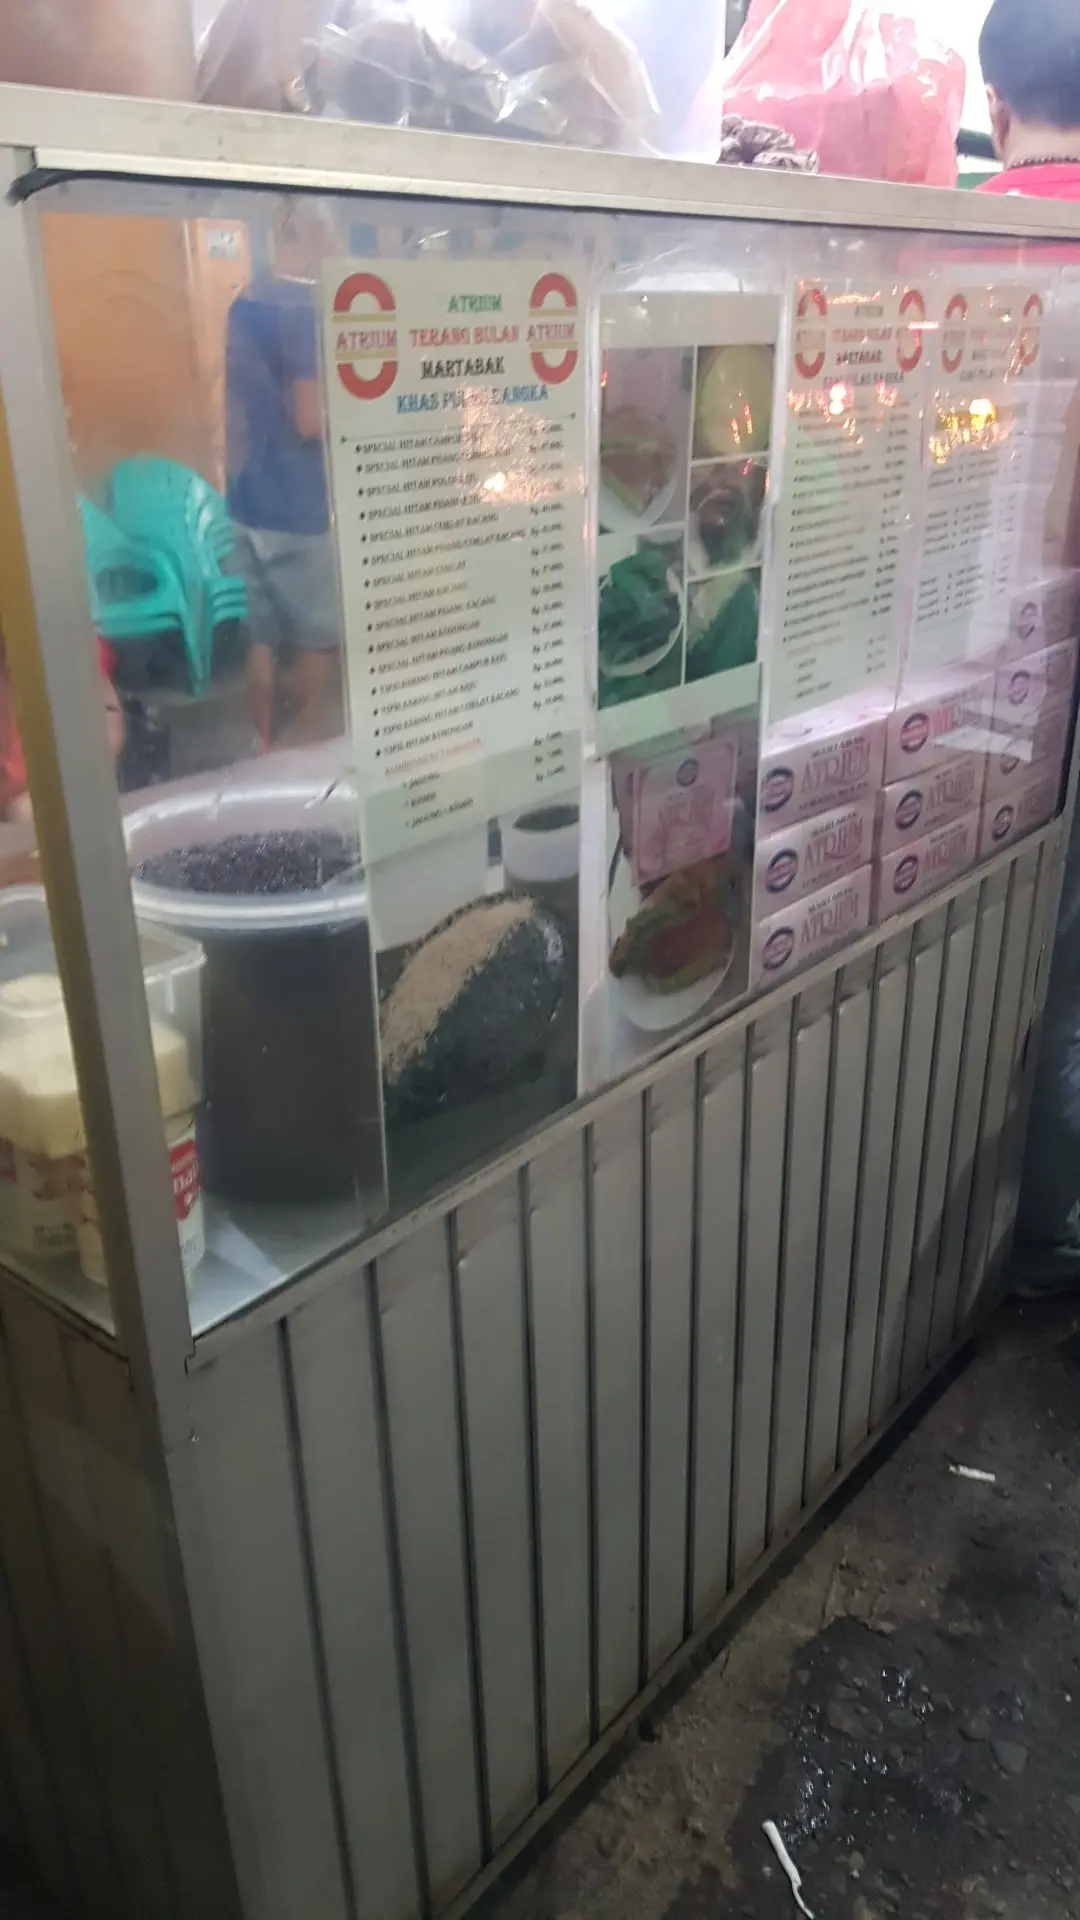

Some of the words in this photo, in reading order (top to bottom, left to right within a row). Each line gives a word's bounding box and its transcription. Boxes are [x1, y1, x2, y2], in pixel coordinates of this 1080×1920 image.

[447, 293, 503, 314] ATRIUM
[335, 328, 398, 351] ATRIUM
[409, 326, 471, 348] TERANG
[473, 323, 519, 345] BULAN
[526, 323, 576, 343] ATRIUM
[420, 356, 506, 380] MARTABAK
[396, 391, 440, 414] KHAS
[800, 742, 871, 793] ATRIUM
